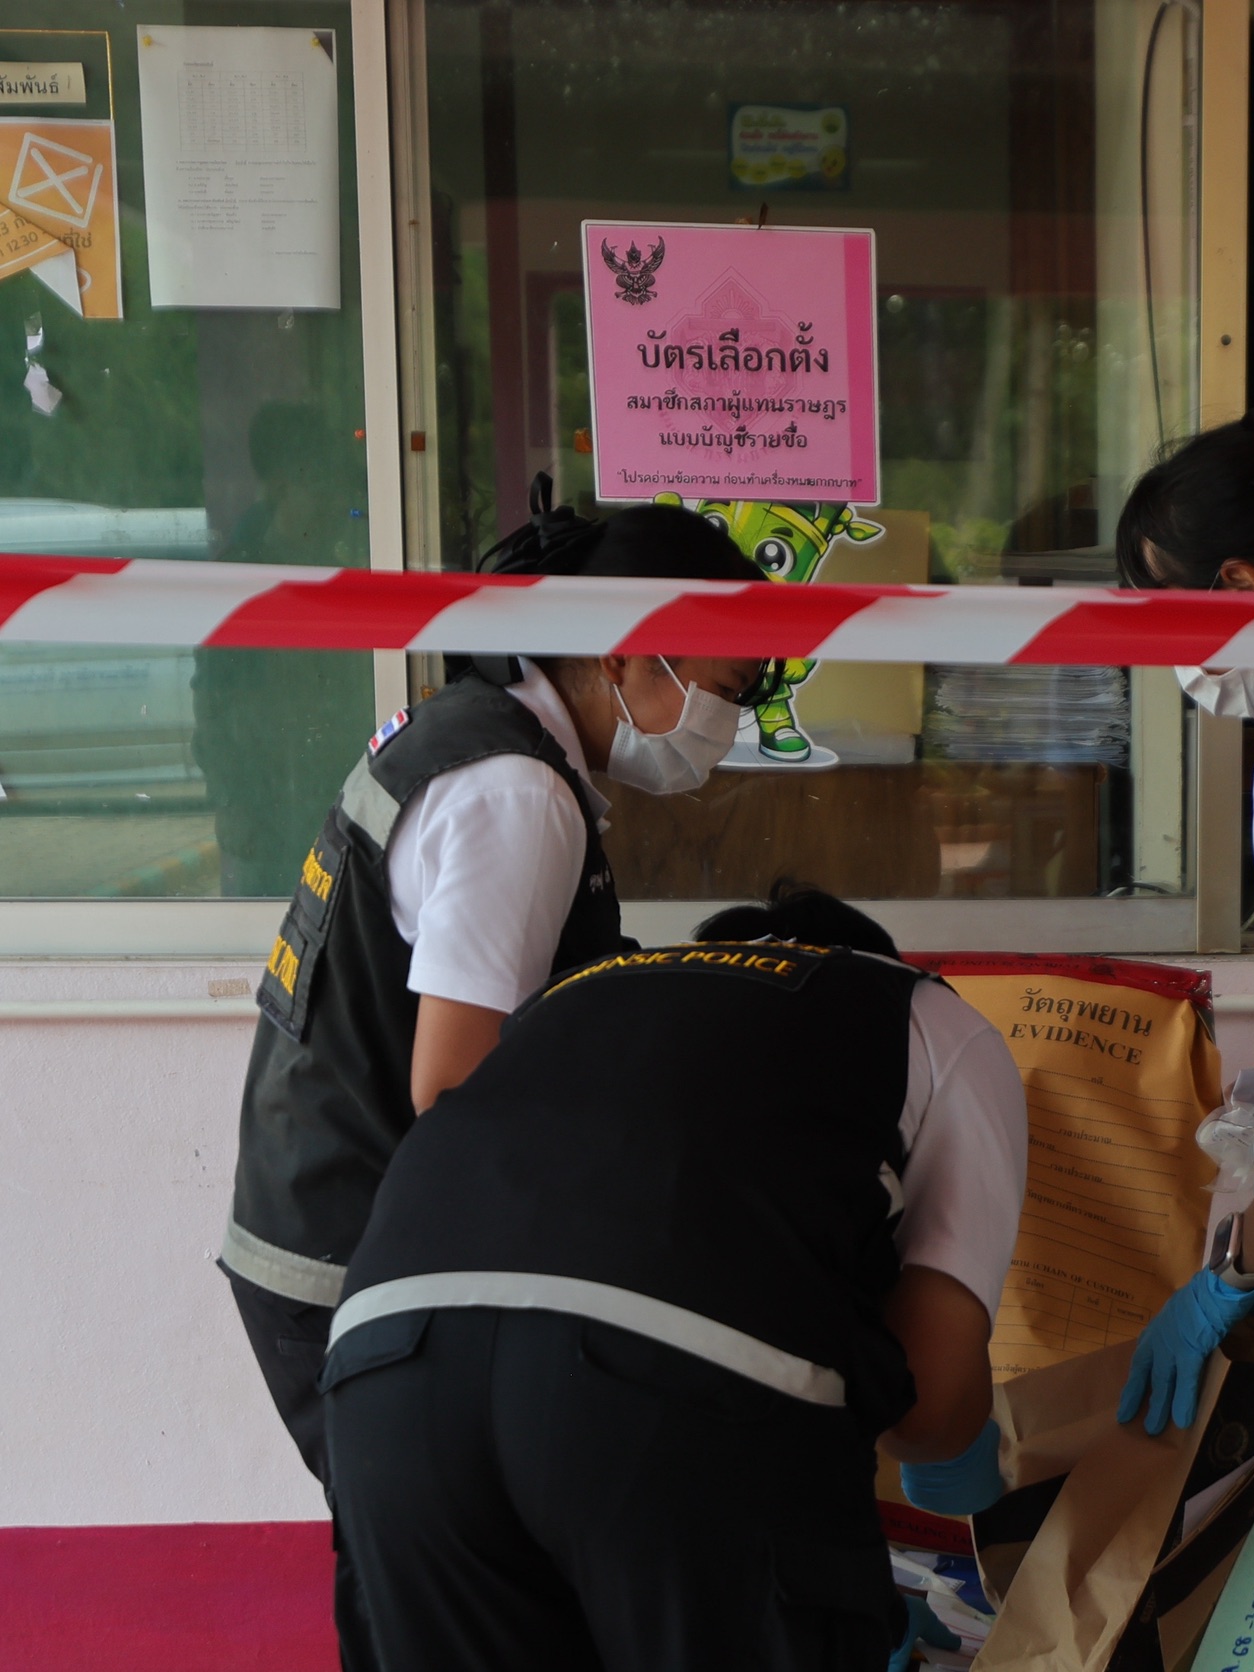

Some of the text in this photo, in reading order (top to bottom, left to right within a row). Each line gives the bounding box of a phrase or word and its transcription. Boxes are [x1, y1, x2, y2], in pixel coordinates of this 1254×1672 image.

[637, 321, 829, 373] บัตรเลือกตั้ง
[626, 387, 847, 420] สมาชิกสภาผู้แทนราษฎร
[659, 422, 808, 454] แบบบัญชีรายชื่อ
[680, 950, 798, 978] POLICE
[1019, 987, 1154, 1038] วัตถุพยาน
[1009, 1023, 1144, 1066] EVIDENCE
[1071, 1273, 1084, 1284] OF
